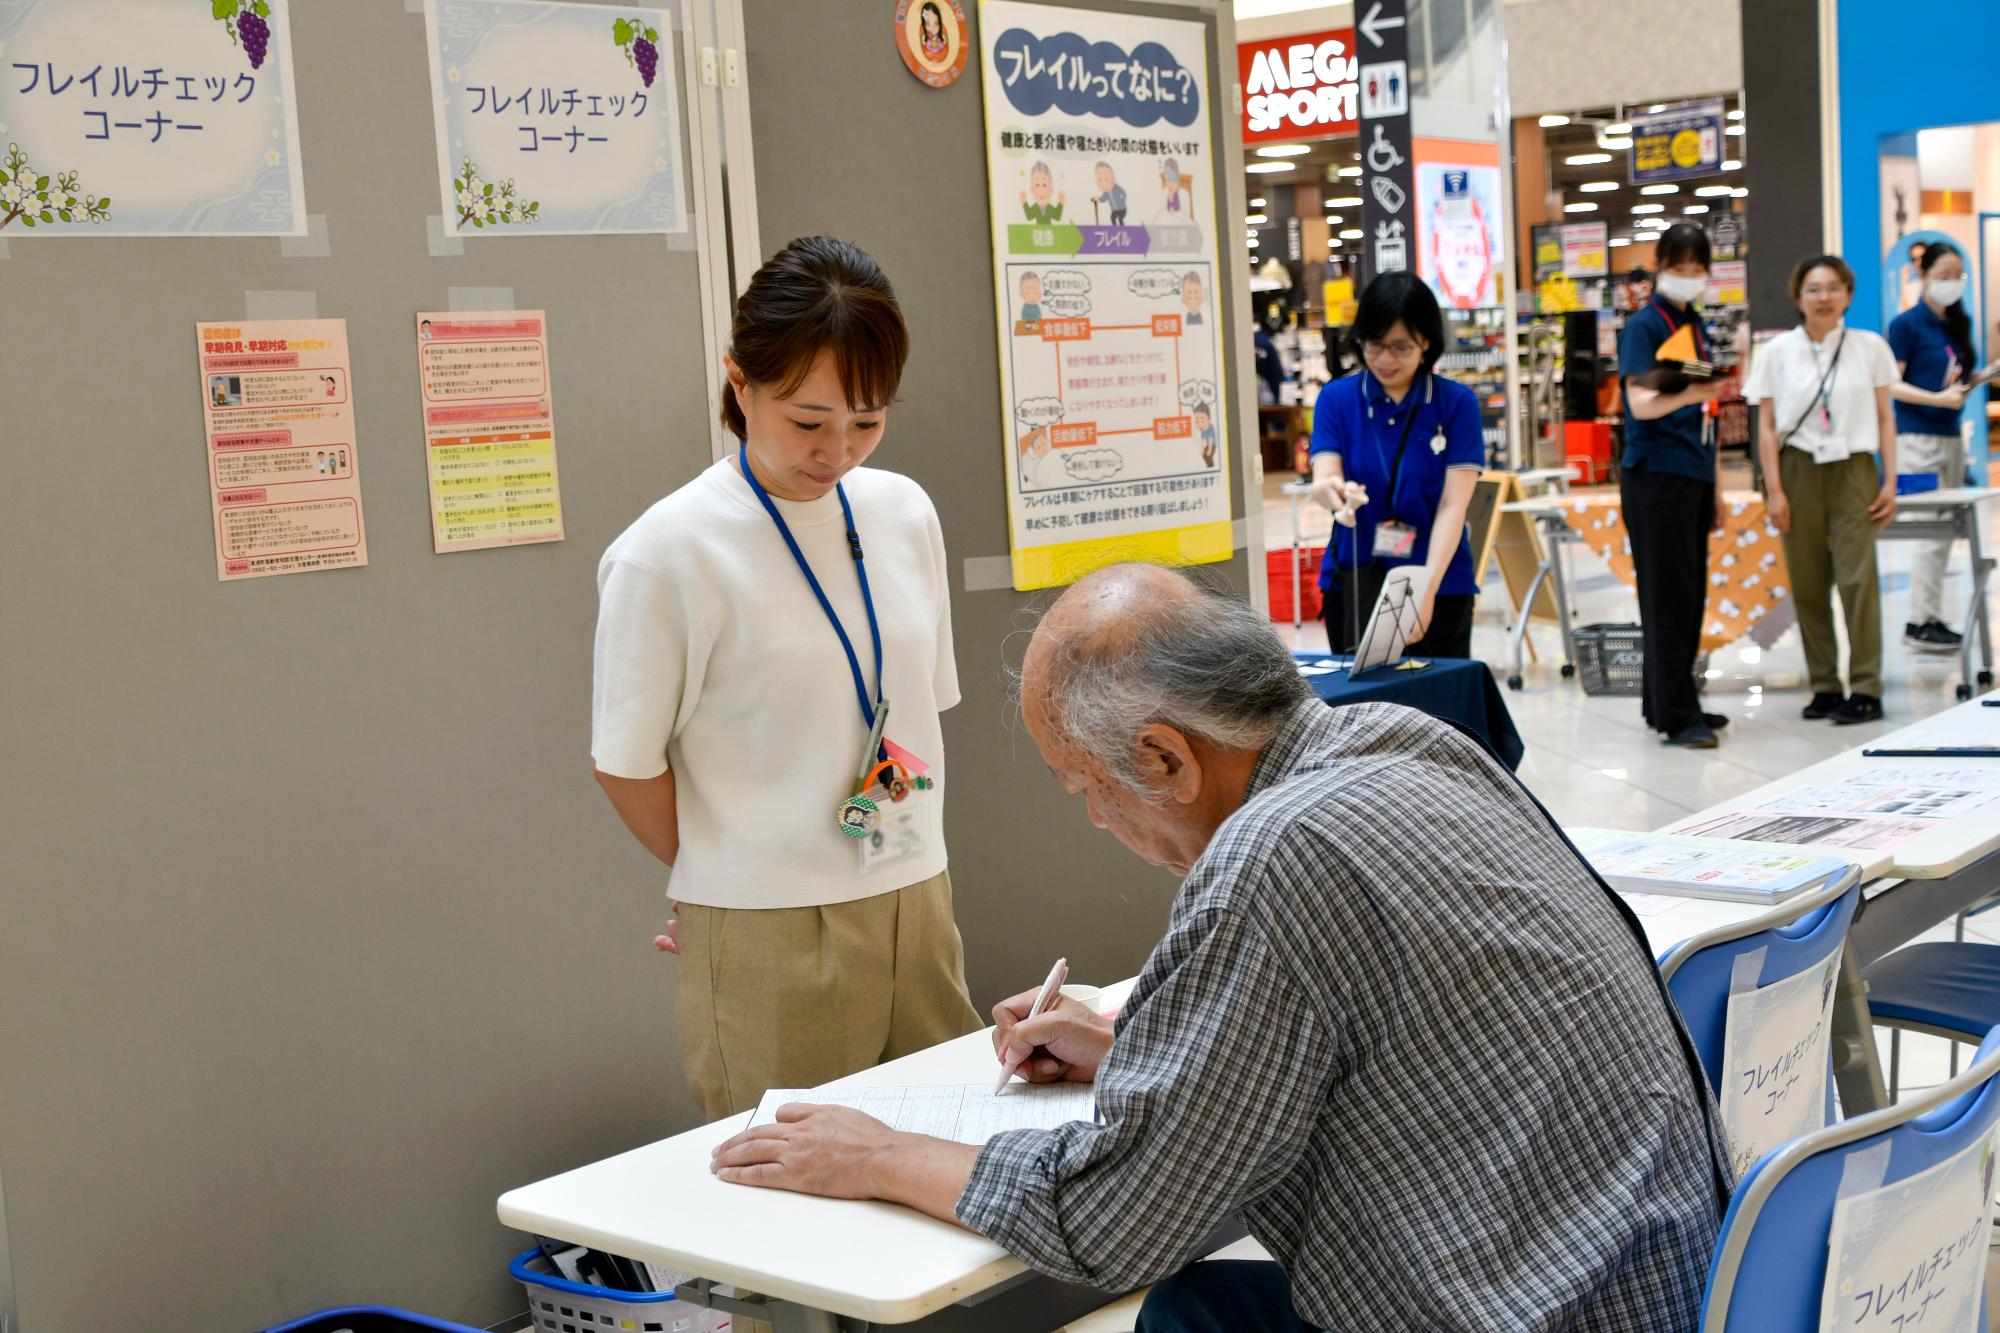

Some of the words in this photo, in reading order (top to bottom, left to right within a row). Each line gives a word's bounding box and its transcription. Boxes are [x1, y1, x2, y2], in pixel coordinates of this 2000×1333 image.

[12, 62, 256, 103] フレイルチェック
[1000, 45, 1192, 104] フレイルってなに？
[466, 86, 649, 119] フレイルチェック
[83, 110, 203, 142] コーナー
[519, 125, 608, 154] コーナー
[1001, 131, 1199, 156] 健康と要介護や寝たきりの間の状態をいいます
[1094, 230, 1131, 247] フレイル
[1743, 1020, 1821, 1096] フレイルチェック
[1764, 1073, 1800, 1116] コーナー
[1854, 1216, 1982, 1325] フレイルチェック
